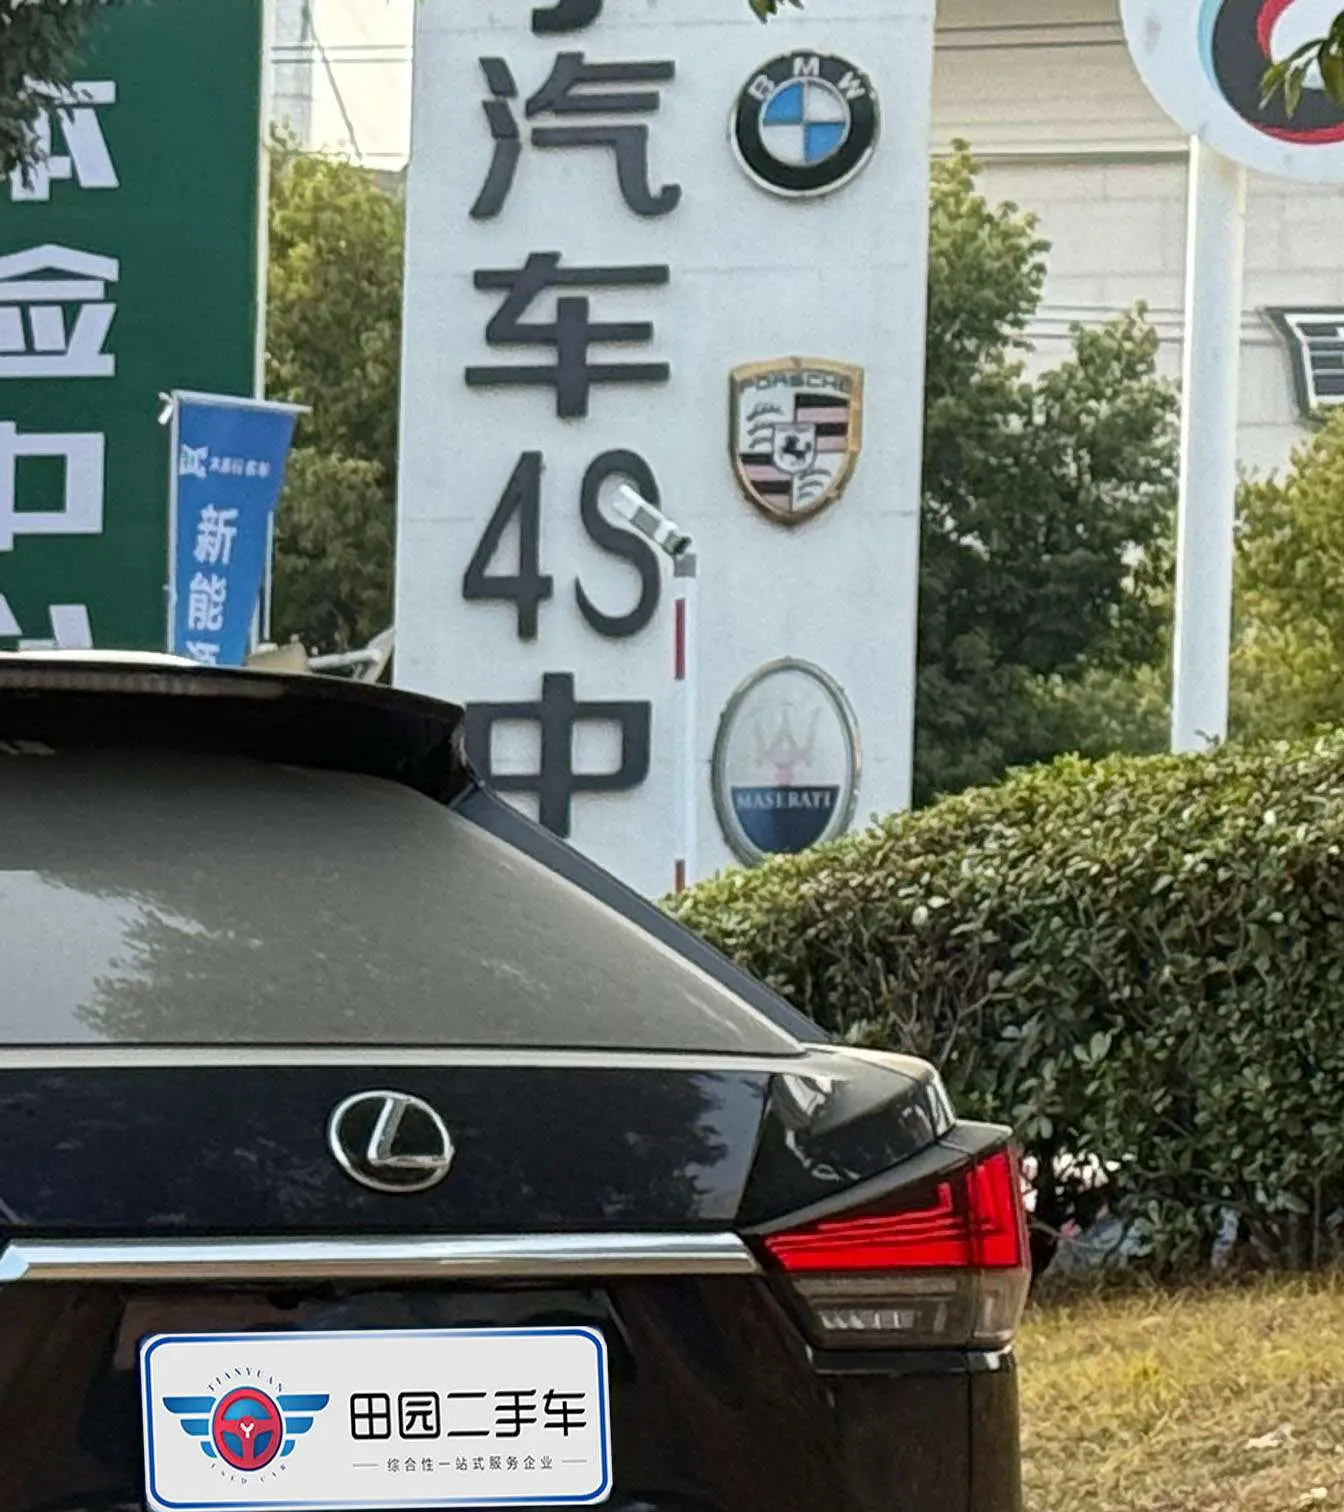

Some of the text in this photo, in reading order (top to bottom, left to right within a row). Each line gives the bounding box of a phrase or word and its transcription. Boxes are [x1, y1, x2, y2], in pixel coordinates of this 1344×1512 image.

[748, 56, 866, 102] BMW
[739, 373, 853, 394] PORSCHE
[463, 0, 682, 840] 汽车4S中
[736, 790, 831, 809] MASERATI
